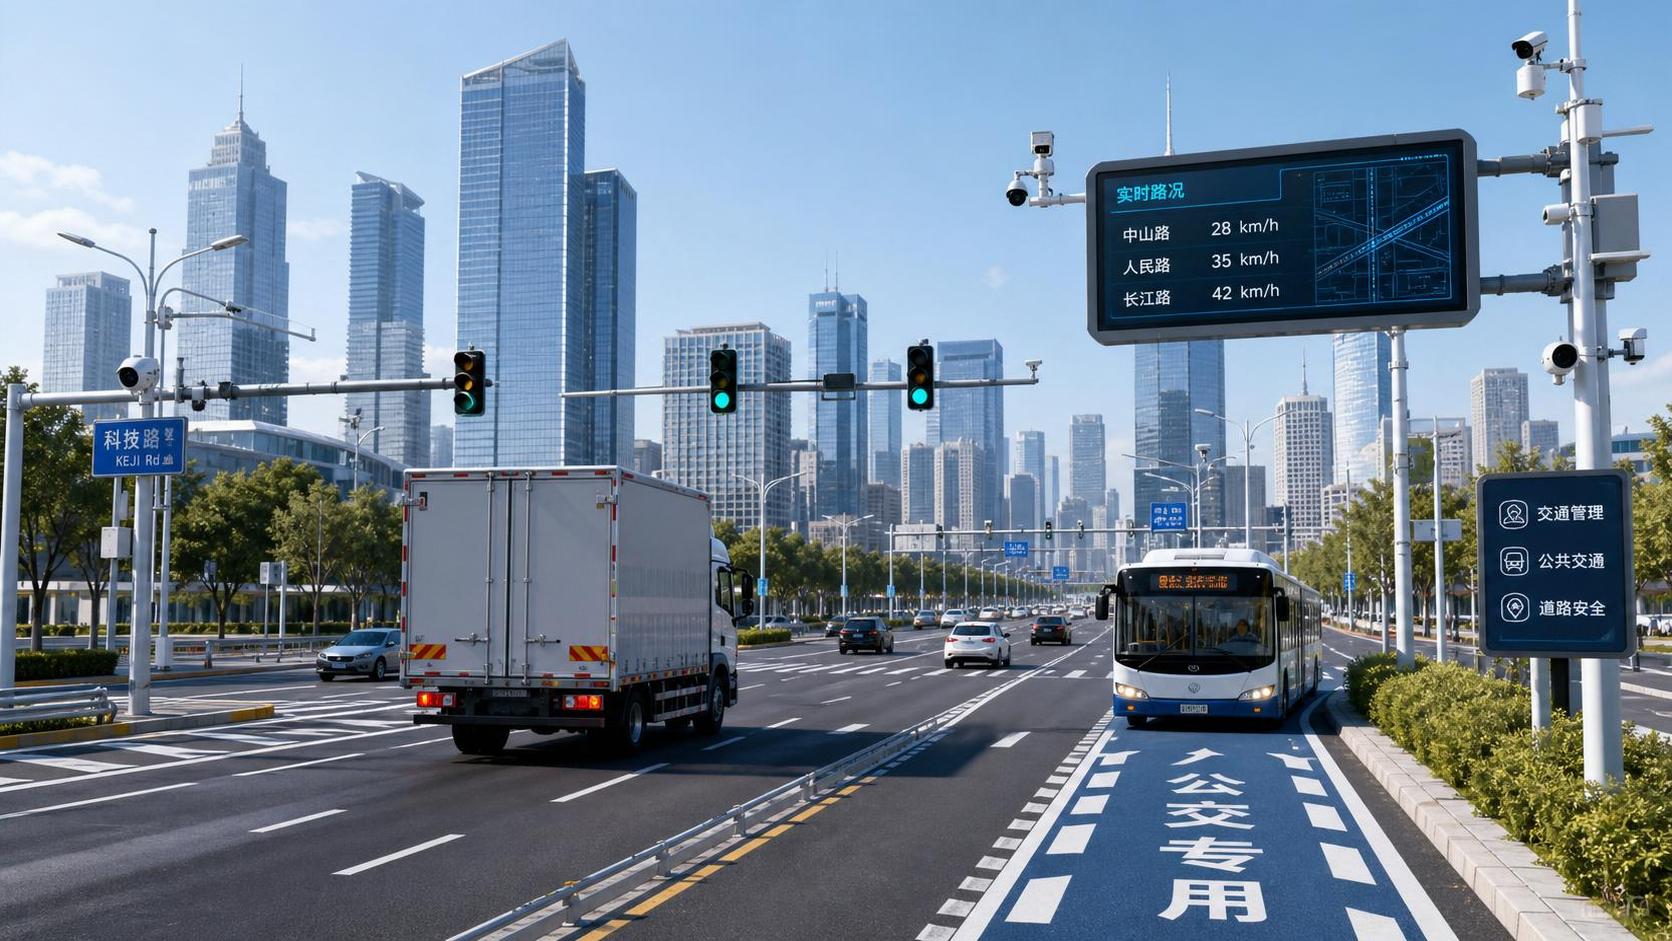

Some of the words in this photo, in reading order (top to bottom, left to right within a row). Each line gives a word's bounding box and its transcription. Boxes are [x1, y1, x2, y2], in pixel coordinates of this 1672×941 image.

[1116, 182, 1184, 204] 实时路况
[1122, 225, 1170, 243] 中山路
[1211, 221, 1231, 236] 28
[1239, 218, 1279, 234] km/h
[1122, 258, 1171, 276] 人民路
[1211, 253, 1232, 269] 35
[1240, 250, 1279, 267] km/h
[1123, 290, 1171, 307] 长江路
[1212, 285, 1232, 301] 42
[1240, 283, 1280, 299] km/h
[116, 455, 140, 467] KEJI
[145, 454, 160, 466] Rd
[1537, 504, 1604, 522] 交通管理
[1538, 553, 1605, 569] 公共交通
[1539, 600, 1606, 617] 道路安全
[1157, 773, 1267, 922] 公交专用
